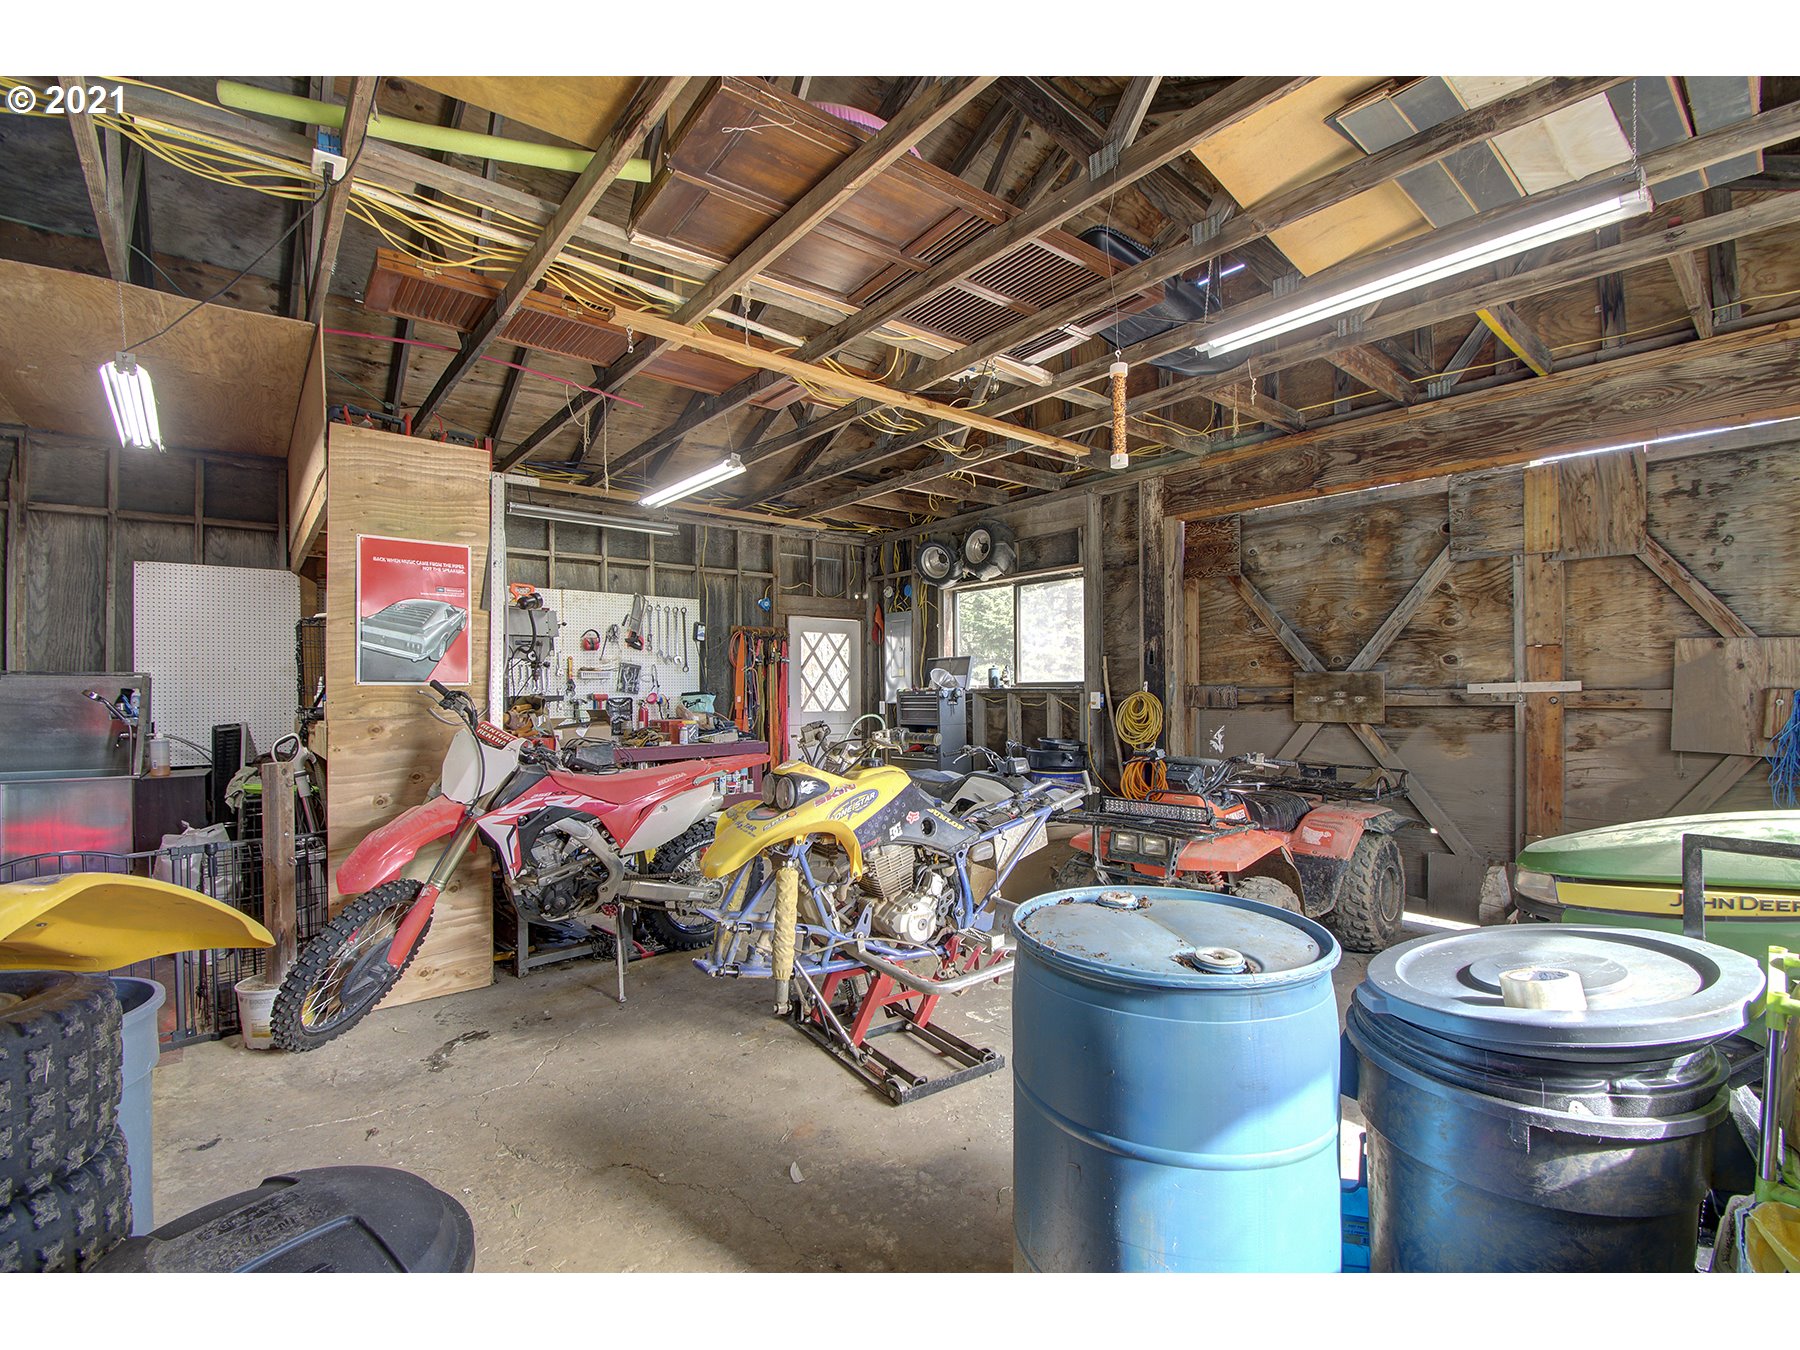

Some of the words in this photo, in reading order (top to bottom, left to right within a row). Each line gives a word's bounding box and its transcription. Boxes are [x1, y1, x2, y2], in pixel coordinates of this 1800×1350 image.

[477, 728, 507, 746] RENTHA
[480, 723, 514, 742] RENTHAL
[656, 772, 687, 787] HONDA
[853, 791, 876, 809] STAR
[926, 808, 966, 831] DUNLOP
[1669, 893, 1736, 910] JHN
